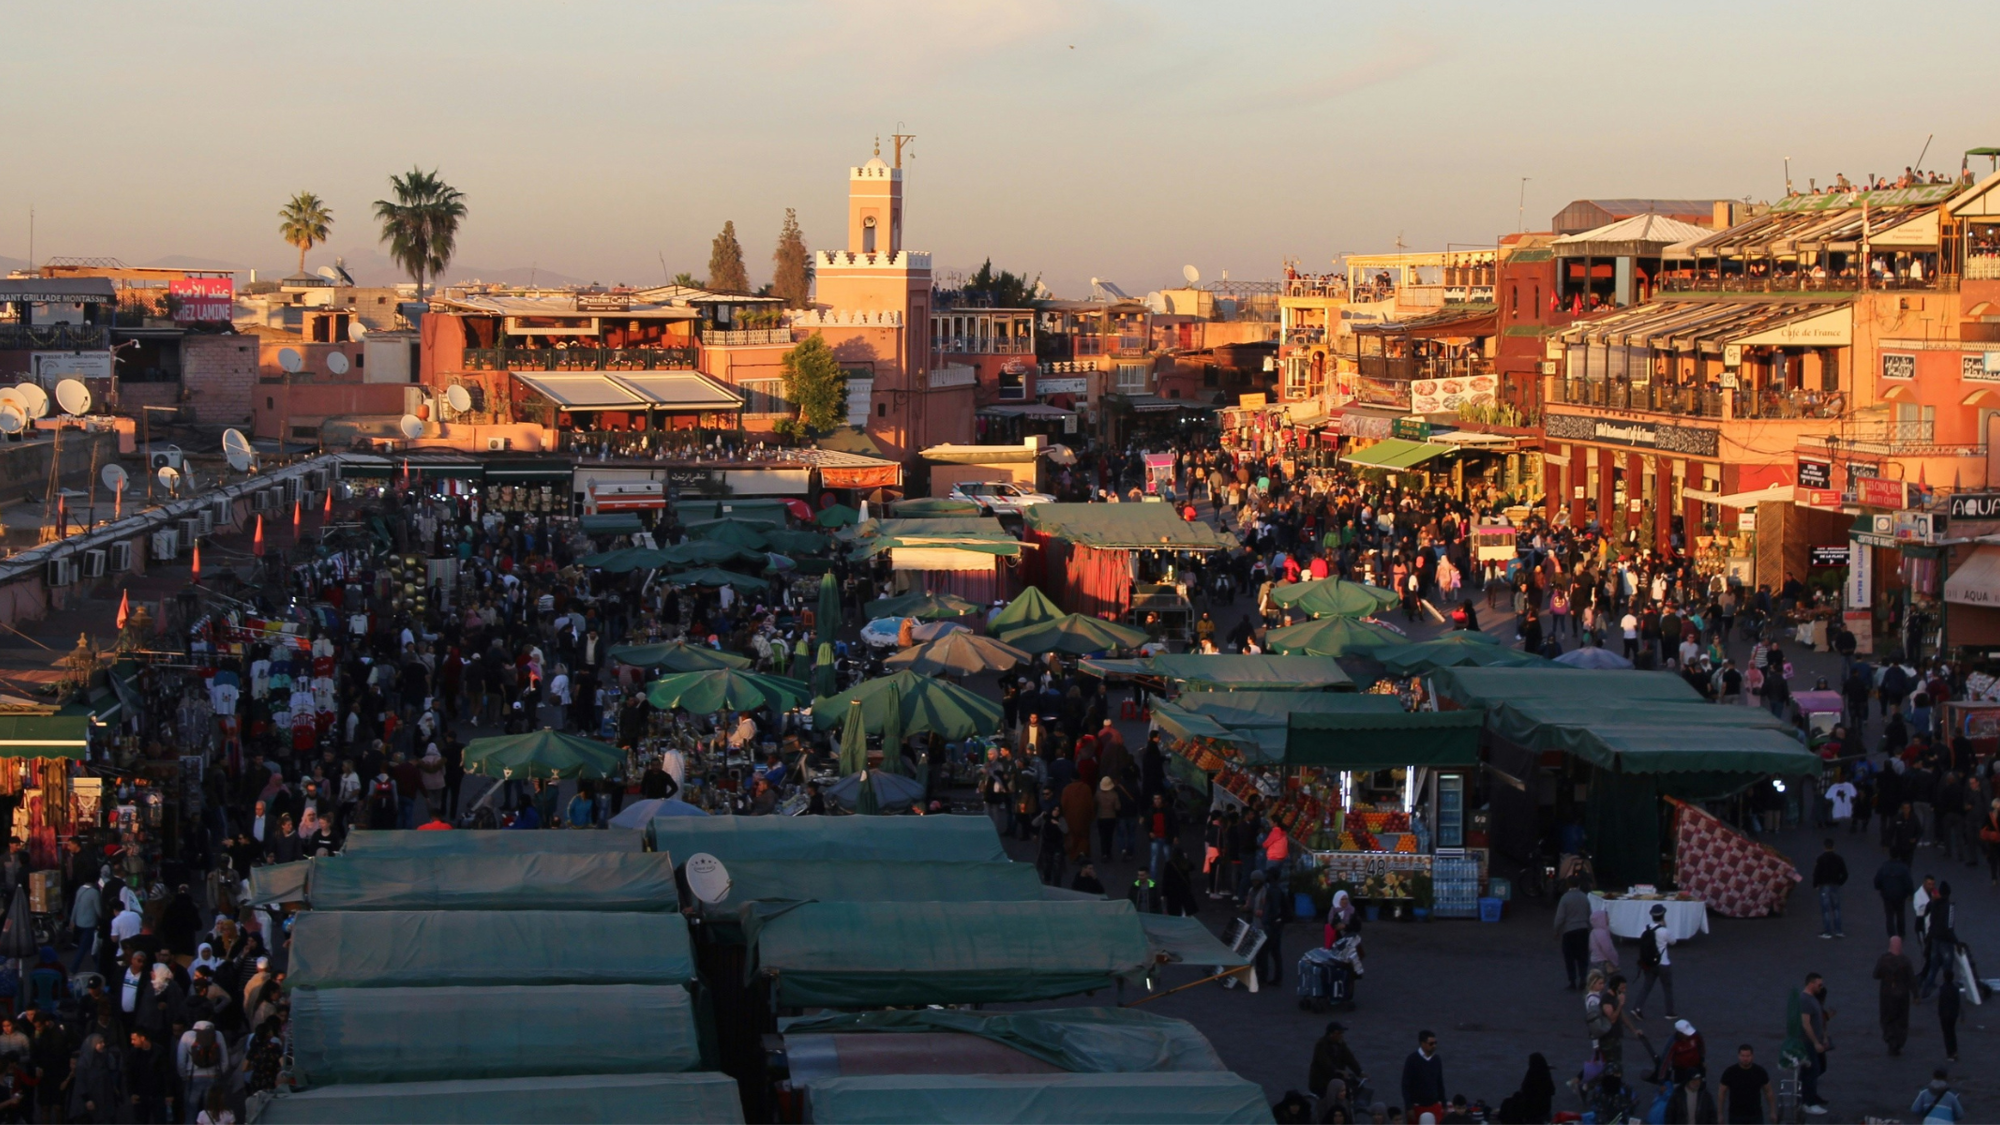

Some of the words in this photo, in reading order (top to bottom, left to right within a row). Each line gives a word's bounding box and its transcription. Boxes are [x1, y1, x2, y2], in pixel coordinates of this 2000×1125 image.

[1771, 195, 1828, 211] CAFE
[1868, 184, 1951, 206] FRANCE
[22, 294, 61, 302] GRILLADE
[62, 294, 108, 303] MONTASSIR
[208, 284, 230, 299] عند
[197, 303, 231, 321] LAMINE
[1781, 328, 1800, 339] Café
[1801, 328, 1811, 337] de
[1814, 329, 1841, 337] France
[1866, 480, 1875, 491] LES
[1874, 481, 1890, 495] CINQ
[1889, 482, 1902, 494] SENS
[1867, 494, 1883, 504] BEAUTY
[1883, 495, 1901, 506] CENTER
[1952, 498, 2000, 516] AQUA
[1964, 590, 1988, 602] AQUA
[1366, 859, 1386, 878] 48
